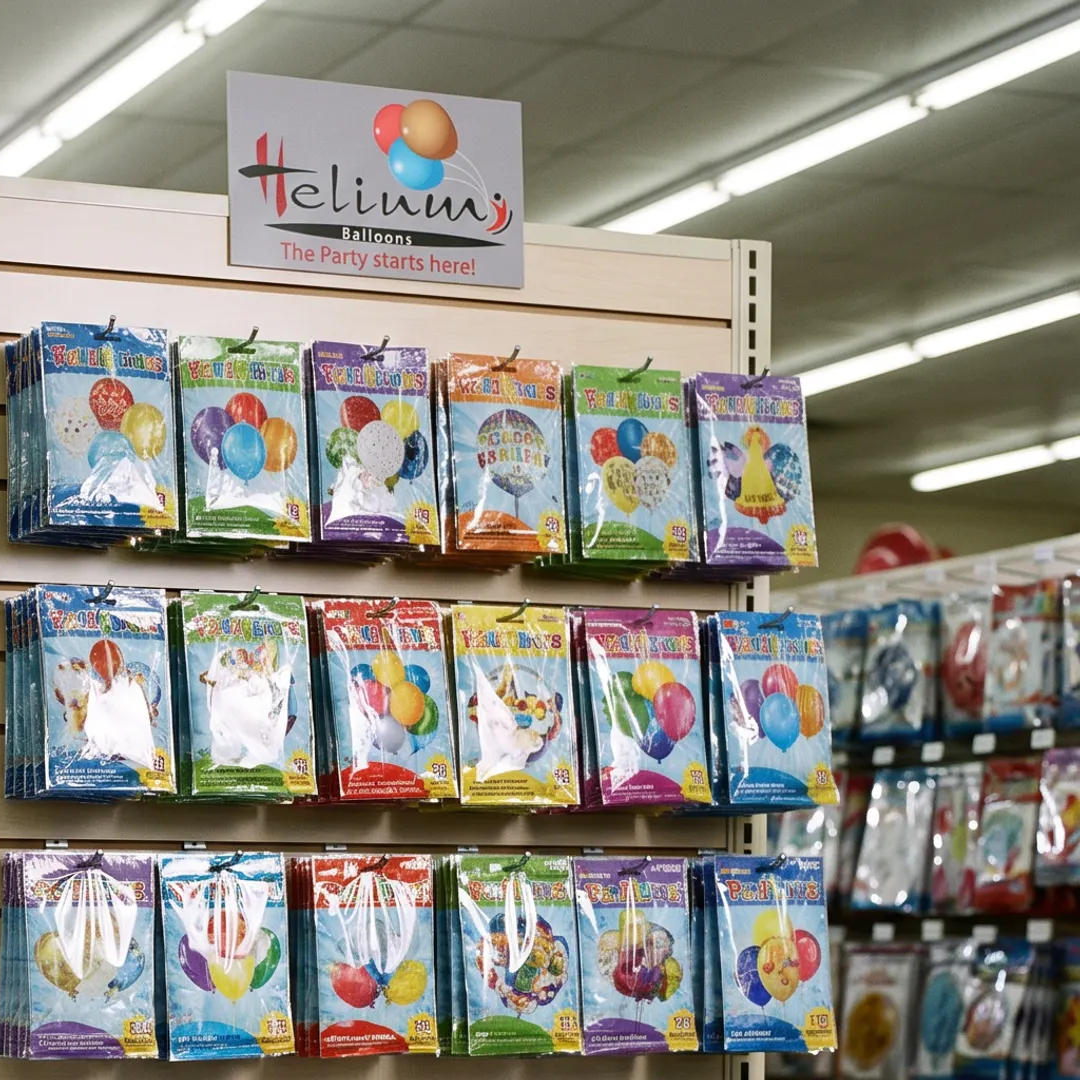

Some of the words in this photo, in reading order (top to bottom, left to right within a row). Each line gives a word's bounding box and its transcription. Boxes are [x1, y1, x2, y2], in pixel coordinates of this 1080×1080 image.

[342, 227, 413, 246] Balloons
[280, 242, 315, 262] The
[321, 246, 368, 270] Party
[373, 253, 424, 272] starts
[430, 255, 476, 276] here!
